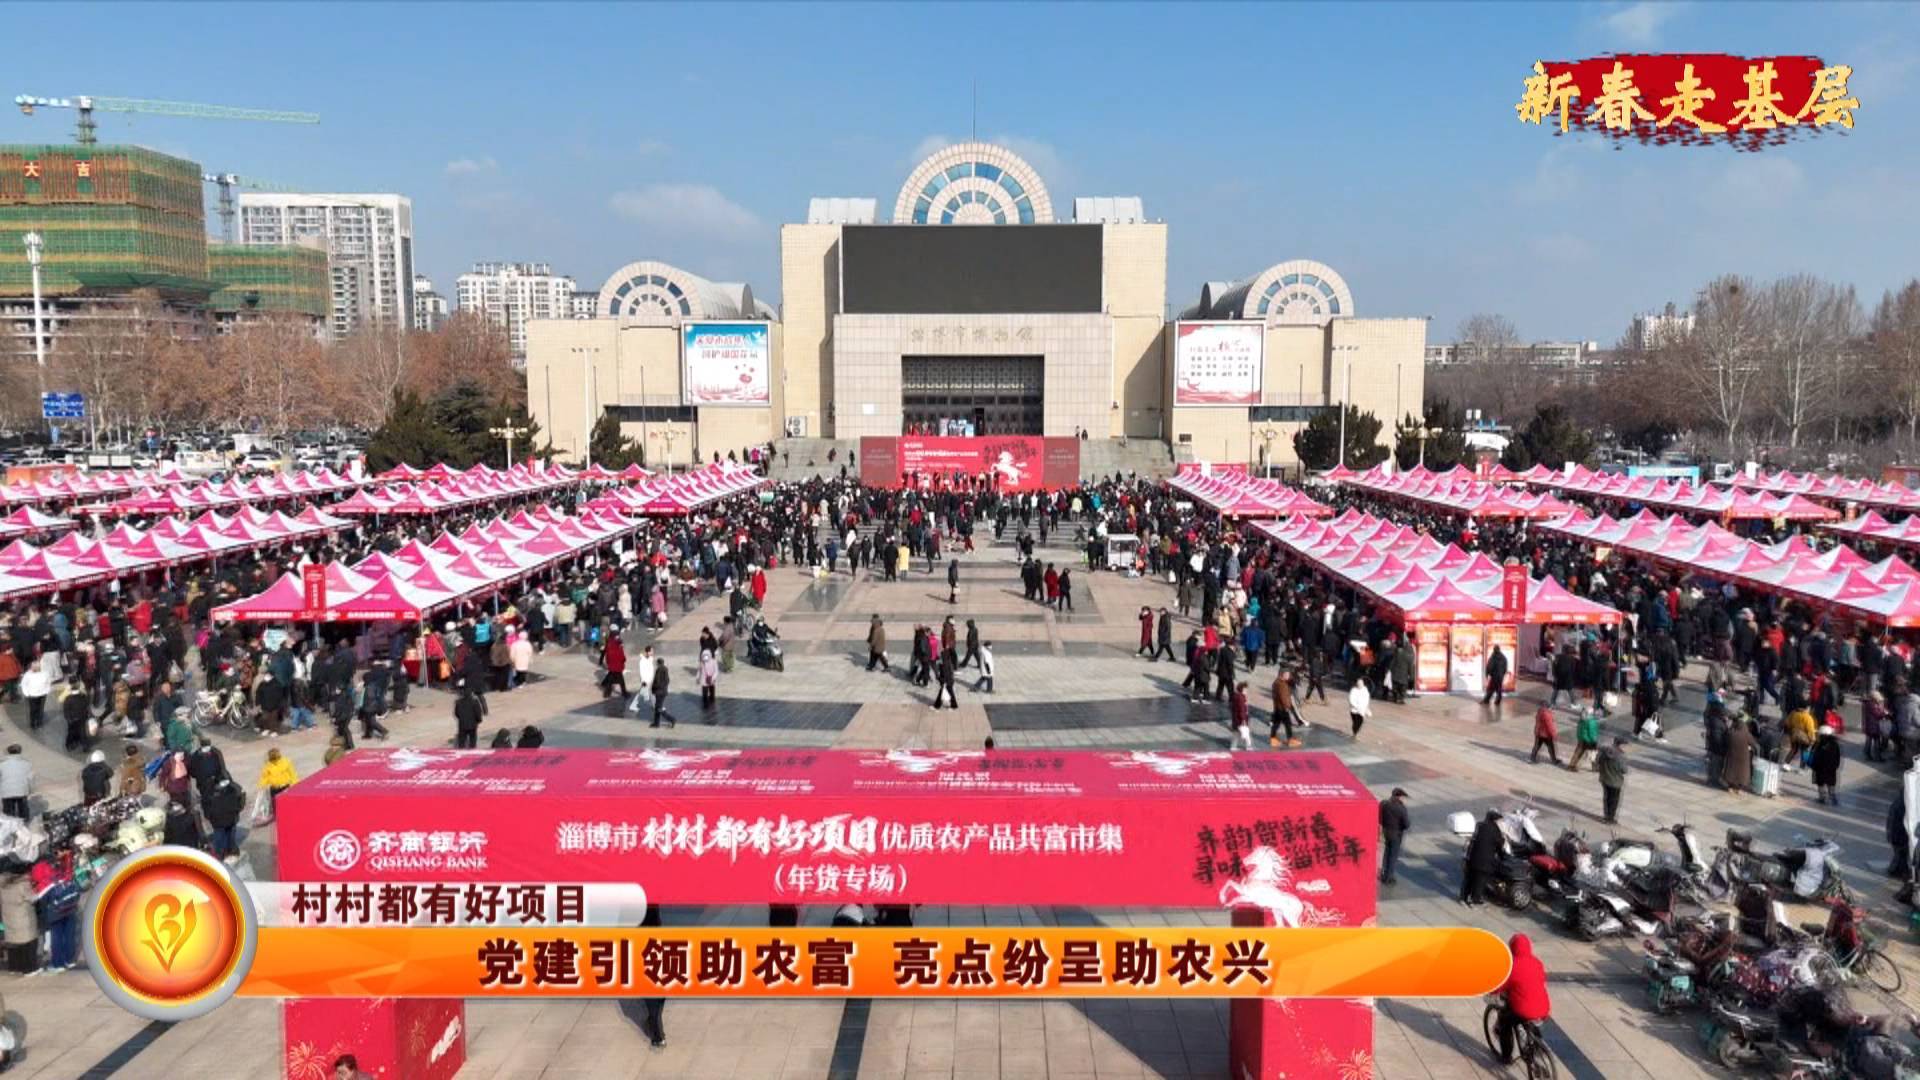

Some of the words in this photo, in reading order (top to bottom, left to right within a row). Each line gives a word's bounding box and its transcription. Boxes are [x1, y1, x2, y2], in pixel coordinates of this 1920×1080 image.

[367, 831, 489, 854] 齐商银行
[370, 856, 442, 871] QISHANG
[446, 856, 488, 870] BANK
